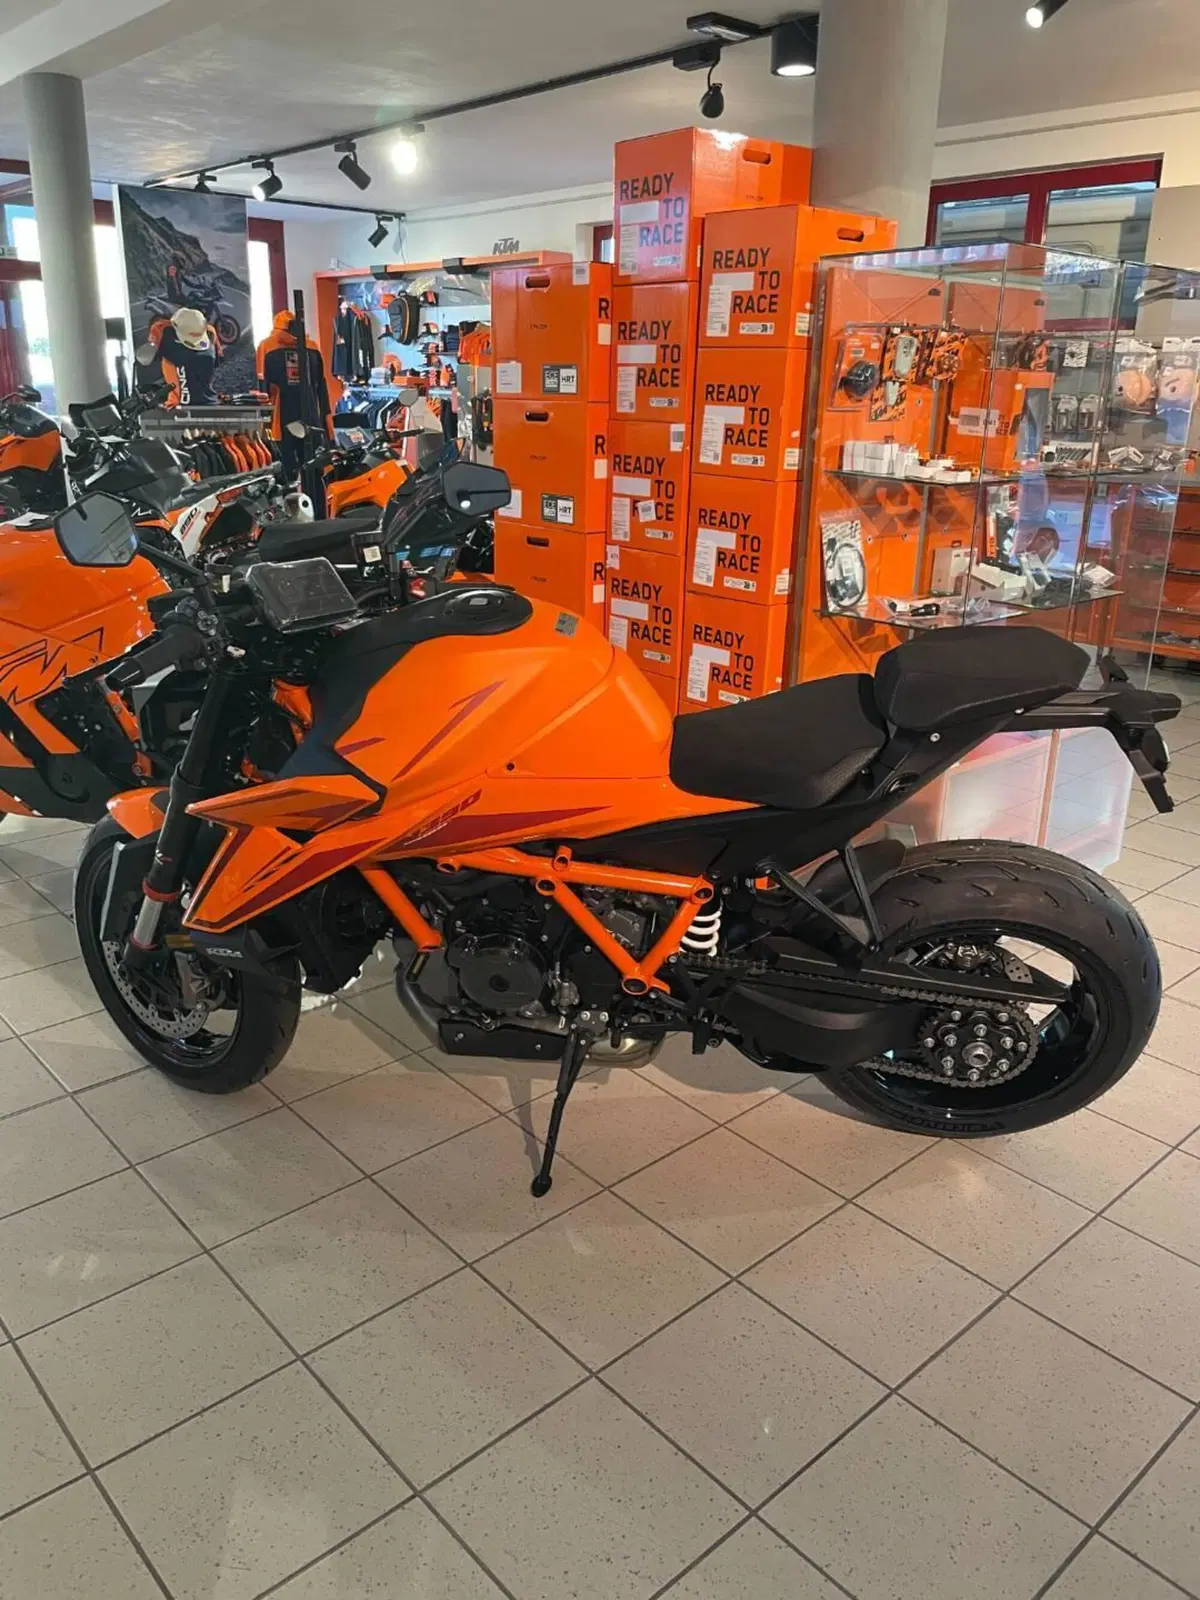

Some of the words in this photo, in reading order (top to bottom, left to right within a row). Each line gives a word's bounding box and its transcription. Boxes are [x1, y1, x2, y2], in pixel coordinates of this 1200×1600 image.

[619, 172, 674, 200] READY
[663, 197, 684, 218] TO
[639, 223, 684, 247] RACE
[493, 238, 519, 255] KTM
[713, 248, 770, 269] READY
[759, 270, 780, 289] TO
[732, 294, 778, 314] RACE
[617, 320, 672, 340] READY
[660, 344, 681, 363] TO
[637, 367, 680, 387] RACE
[705, 384, 760, 403] READY
[749, 407, 770, 426] TO
[724, 427, 768, 448] RACE
[612, 454, 665, 476] READY
[655, 479, 675, 499] TO
[632, 500, 674, 522] RCE
[698, 507, 752, 530] READY
[740, 534, 761, 553] TO
[717, 551, 760, 573] RACE
[611, 578, 662, 601] READY
[652, 605, 672, 625] TO
[630, 622, 672, 646] RACE
[693, 624, 745, 650] READY
[734, 652, 754, 672] TO
[711, 666, 753, 691] RACE
